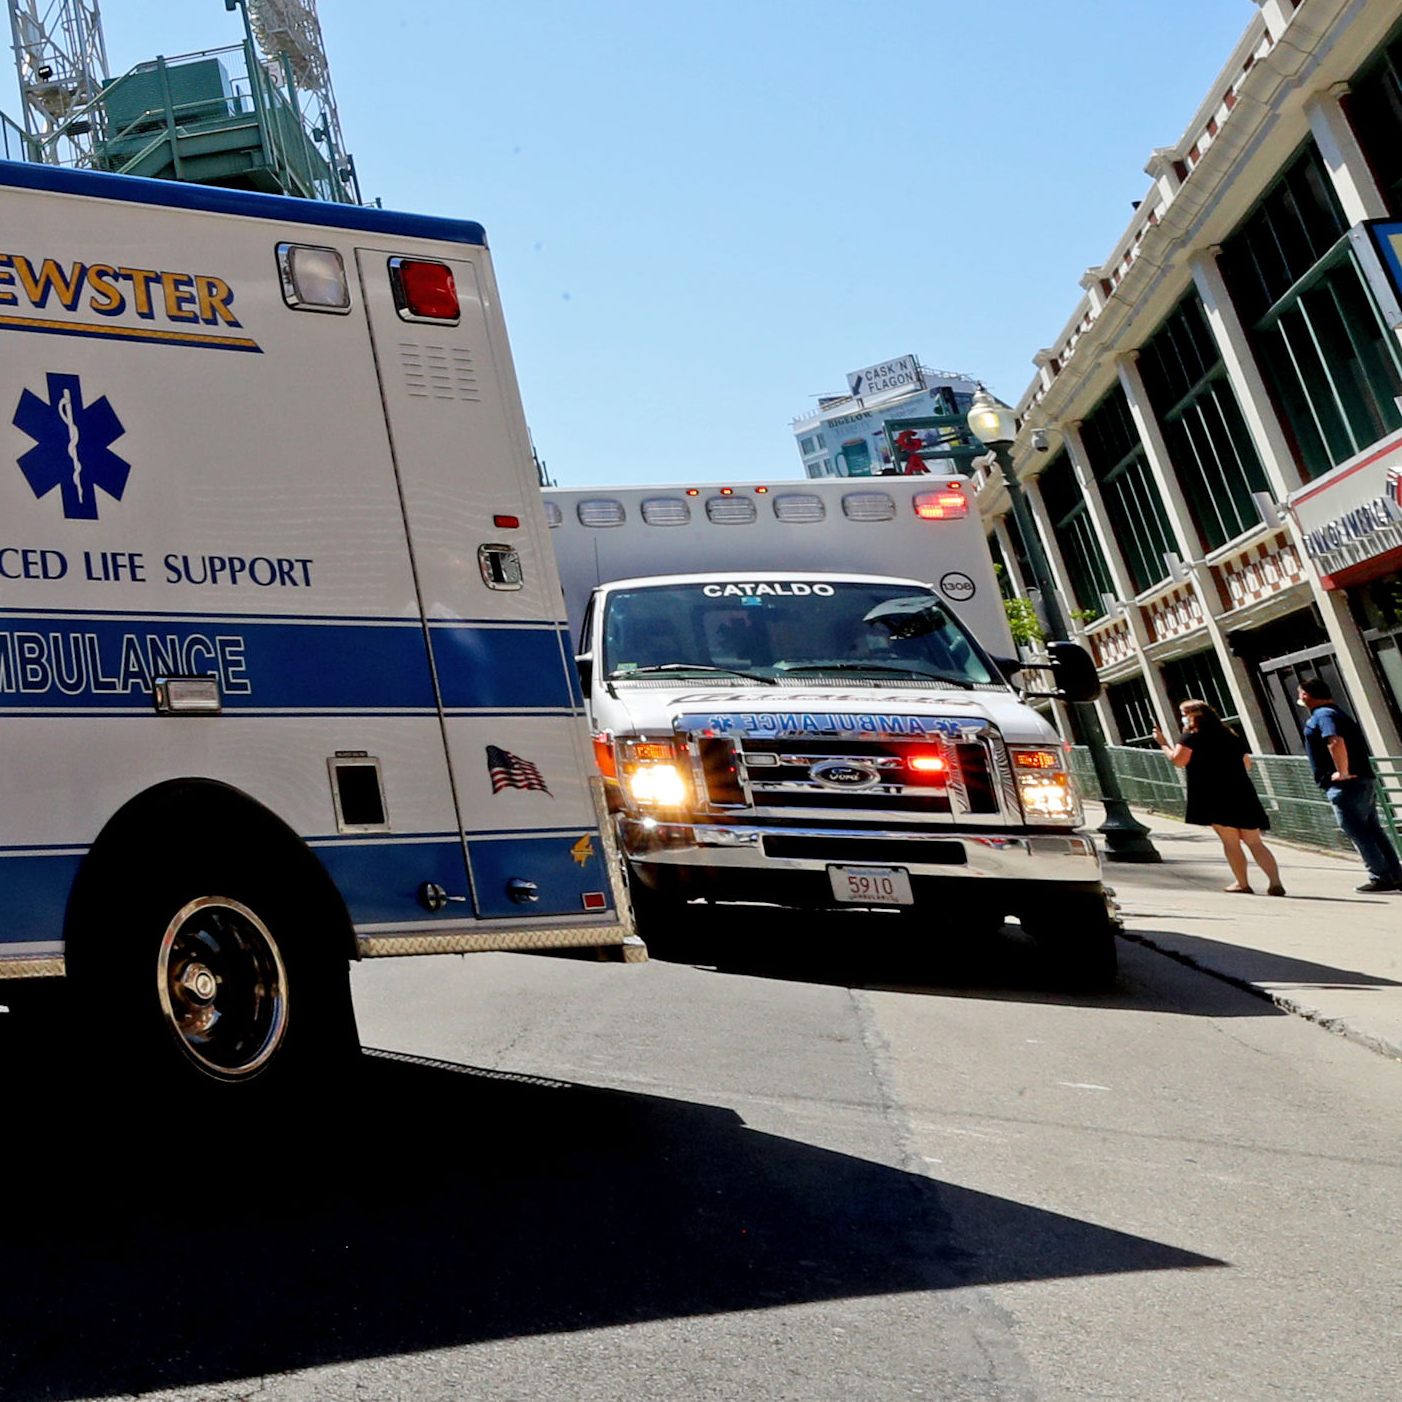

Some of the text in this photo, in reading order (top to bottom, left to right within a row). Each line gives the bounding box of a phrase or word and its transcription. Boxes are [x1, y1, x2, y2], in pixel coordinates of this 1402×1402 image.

[864, 364, 896, 382] CASK
[868, 372, 914, 394] FLAGON
[83, 550, 147, 583] LIFE
[164, 553, 314, 588] SUPPORT
[703, 583, 836, 598] CATALDO
[829, 768, 861, 782] Ford
[848, 876, 894, 895] 5910
